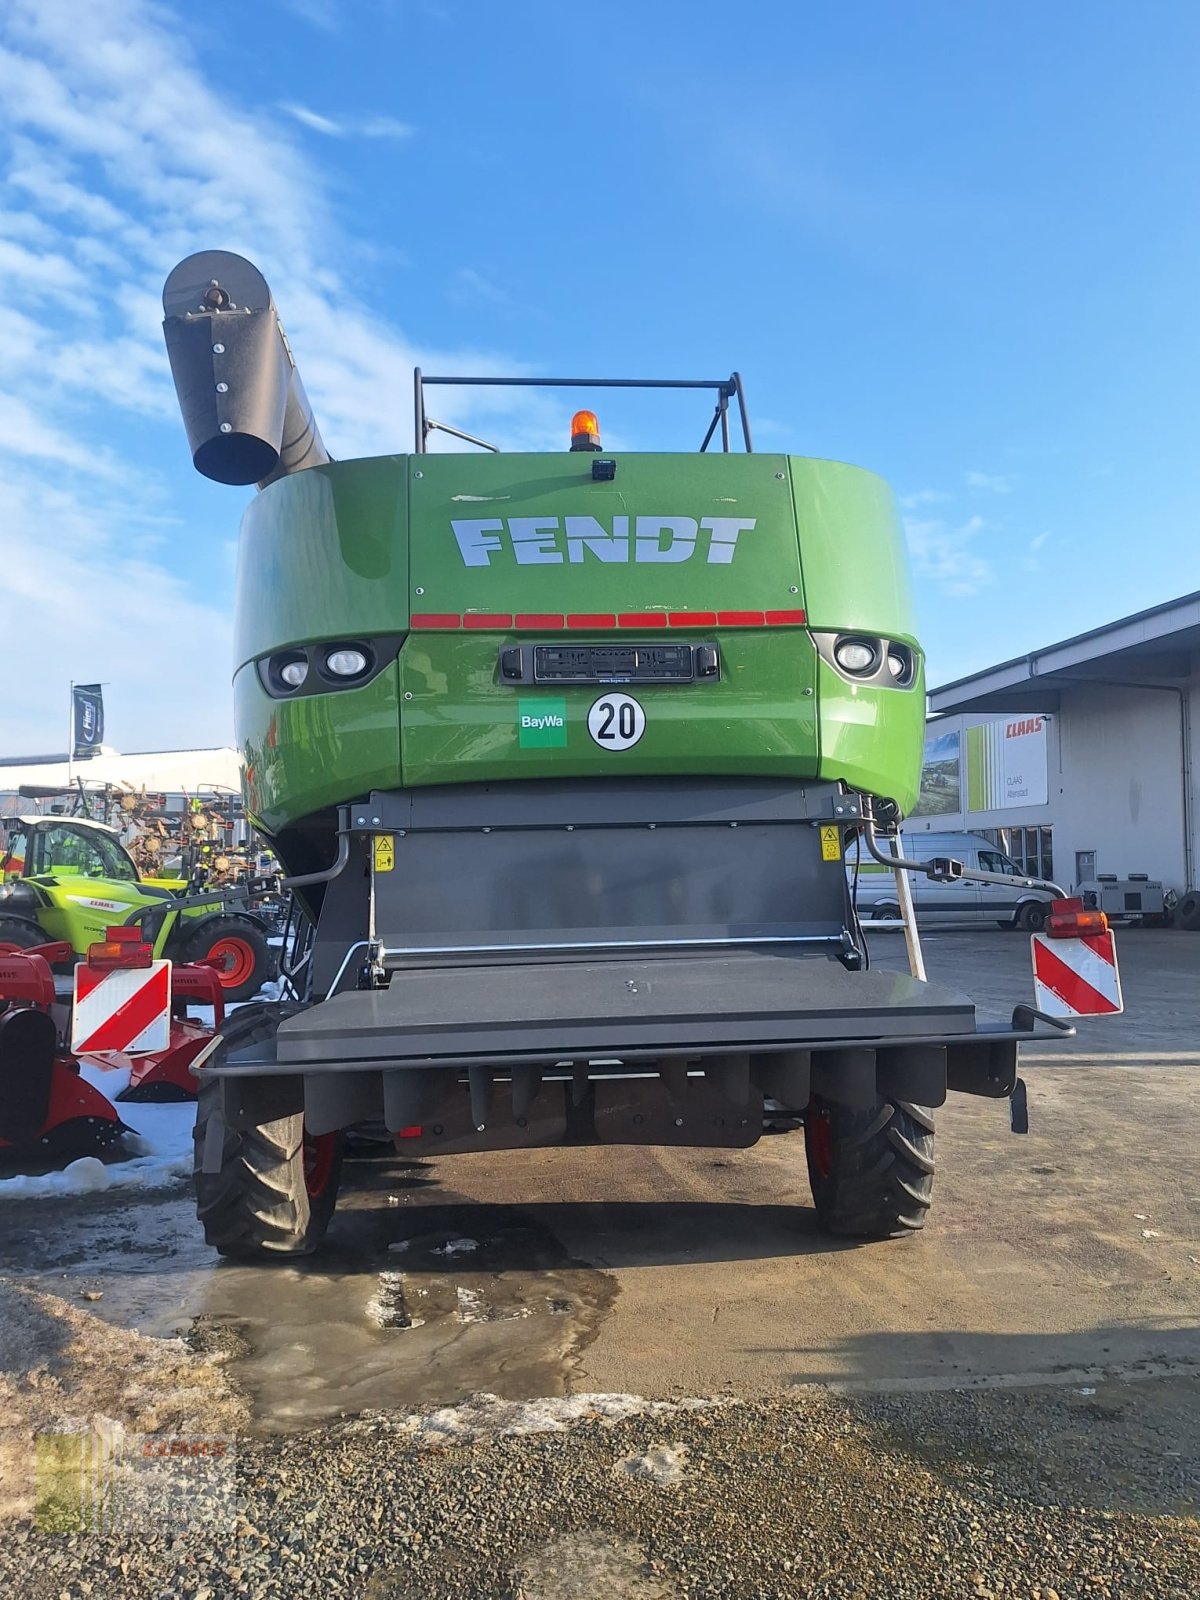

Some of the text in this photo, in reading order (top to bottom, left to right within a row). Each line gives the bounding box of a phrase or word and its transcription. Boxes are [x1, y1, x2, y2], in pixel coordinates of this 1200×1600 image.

[450, 515, 757, 567] FENDT
[521, 714, 563, 730] BayWa
[597, 702, 636, 740] 20
[1006, 716, 1043, 739] CLAAS
[1006, 776, 1023, 786] CLAAS
[90, 900, 115, 909] CLAAS
